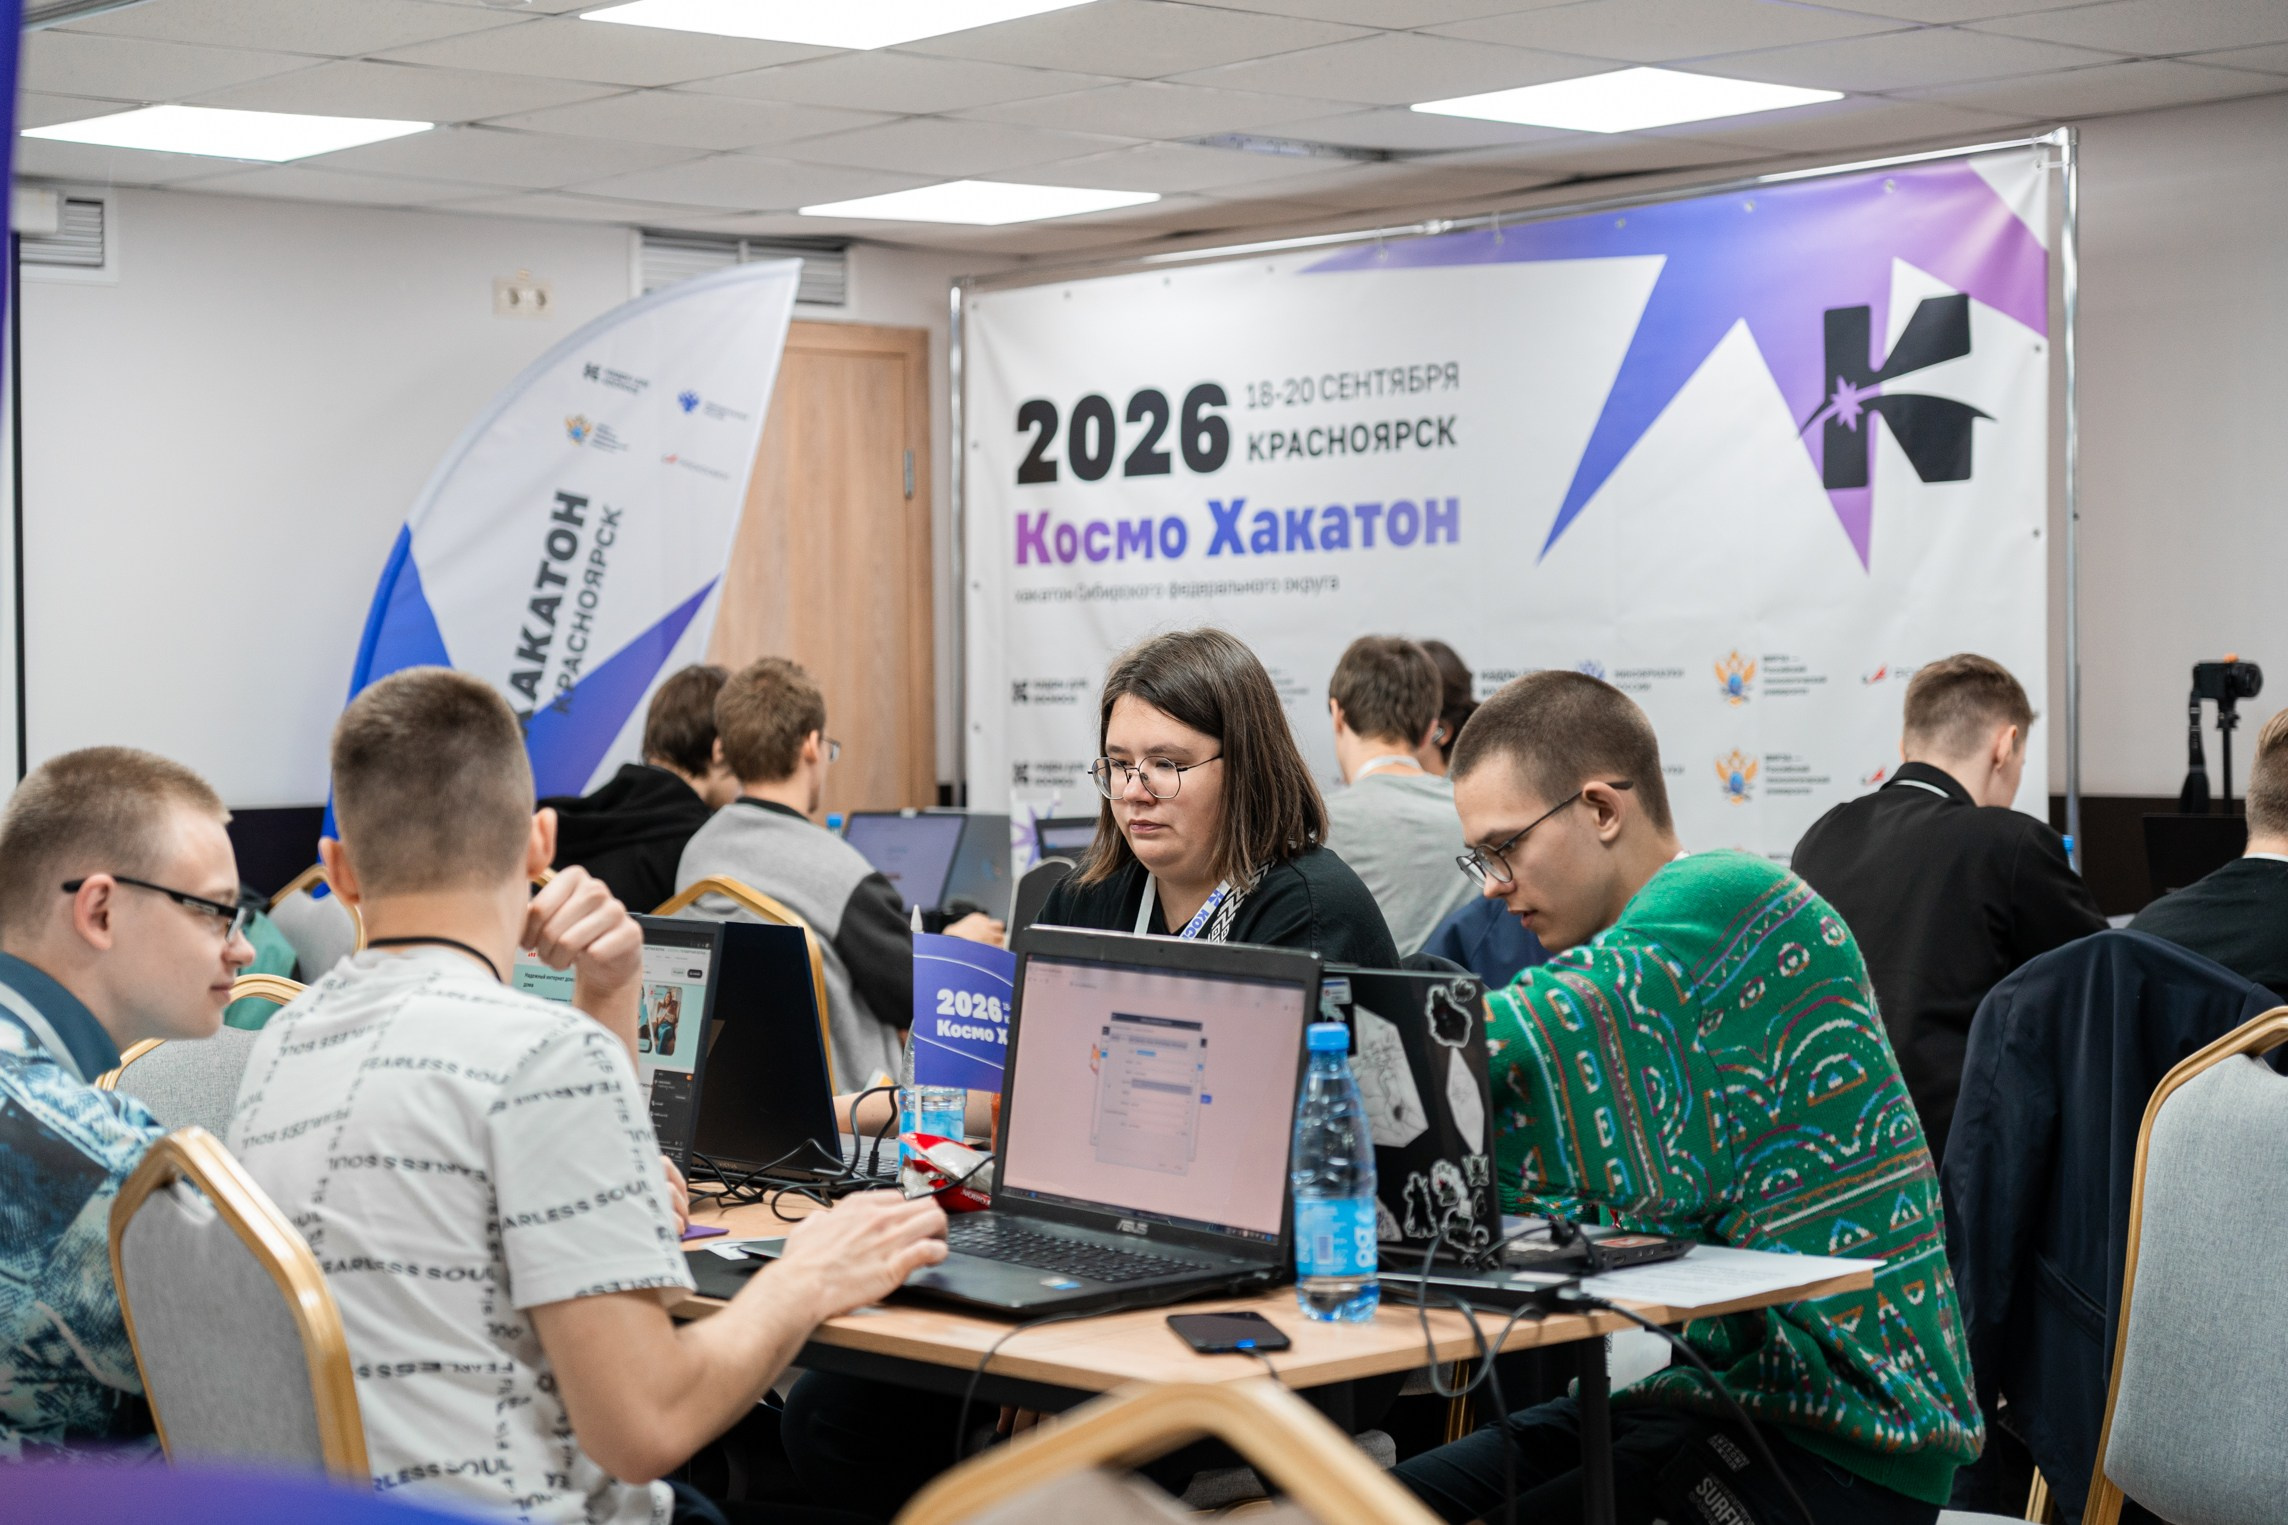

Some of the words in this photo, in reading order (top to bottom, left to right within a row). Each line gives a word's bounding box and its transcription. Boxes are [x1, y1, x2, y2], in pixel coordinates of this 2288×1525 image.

[1320, 361, 1459, 401] СЕНТЯБРЯ
[1016, 383, 1231, 485] 2026
[1248, 415, 1458, 461] КРАСНОЯРСК
[1016, 511, 1187, 565] Космо
[1207, 497, 1460, 557] Хакатон
[1284, 574, 1340, 597] округа
[552, 503, 623, 714] КРАСНОЯРСК
[1182, 909, 1210, 940] КОС
[936, 988, 1003, 1024] 2026
[937, 1019, 996, 1043] Космо
[595, 1180, 652, 1206] SOUL
[1116, 1219, 1149, 1235] ASUS
